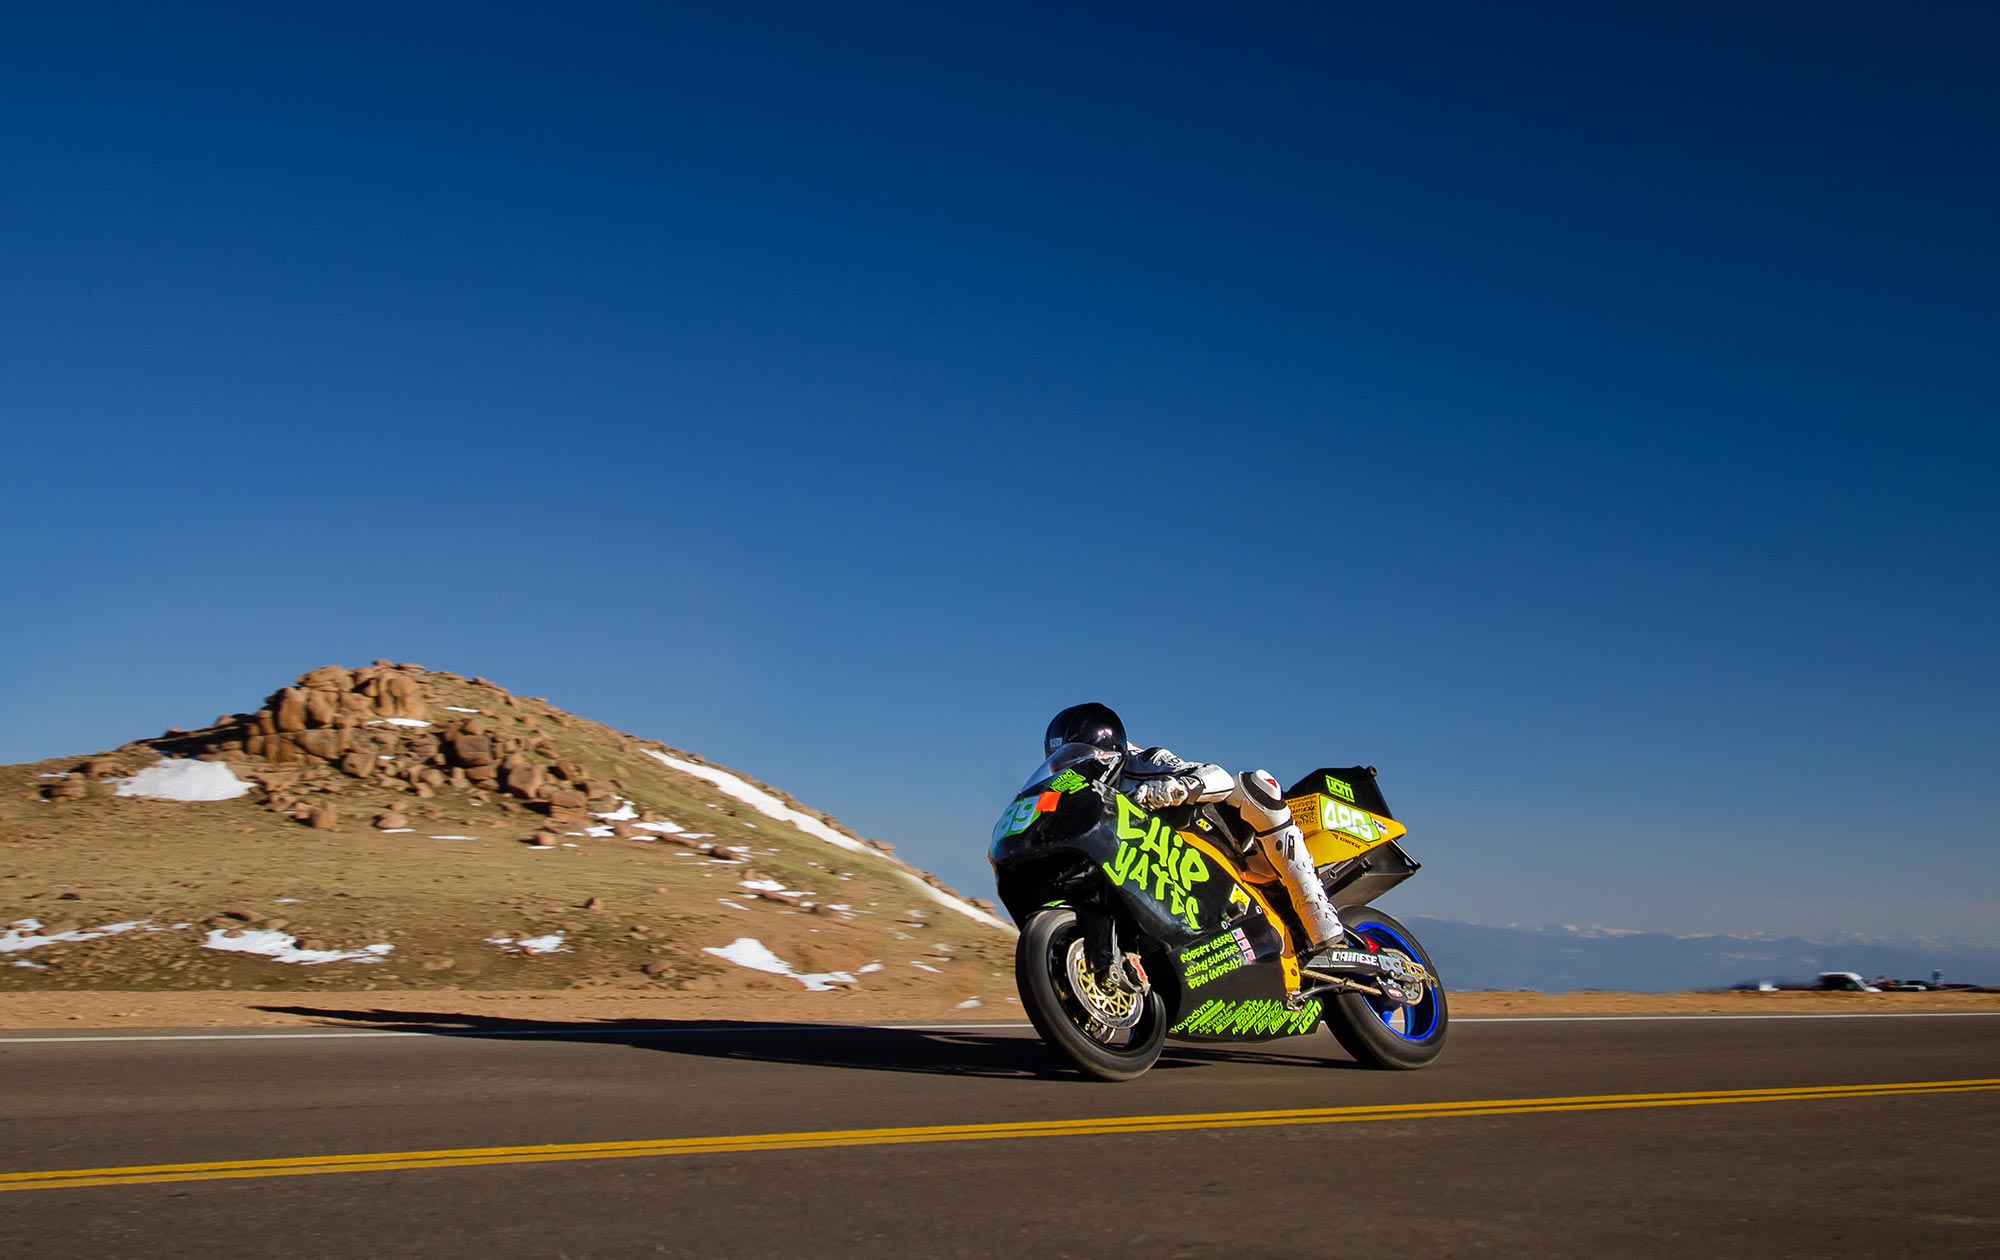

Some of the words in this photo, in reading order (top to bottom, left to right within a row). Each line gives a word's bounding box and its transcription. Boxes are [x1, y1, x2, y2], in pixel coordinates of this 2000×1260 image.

[1180, 944, 1211, 963] ROBERT
[1332, 951, 1378, 966] DAINESE
[1188, 974, 1209, 989] BEN
